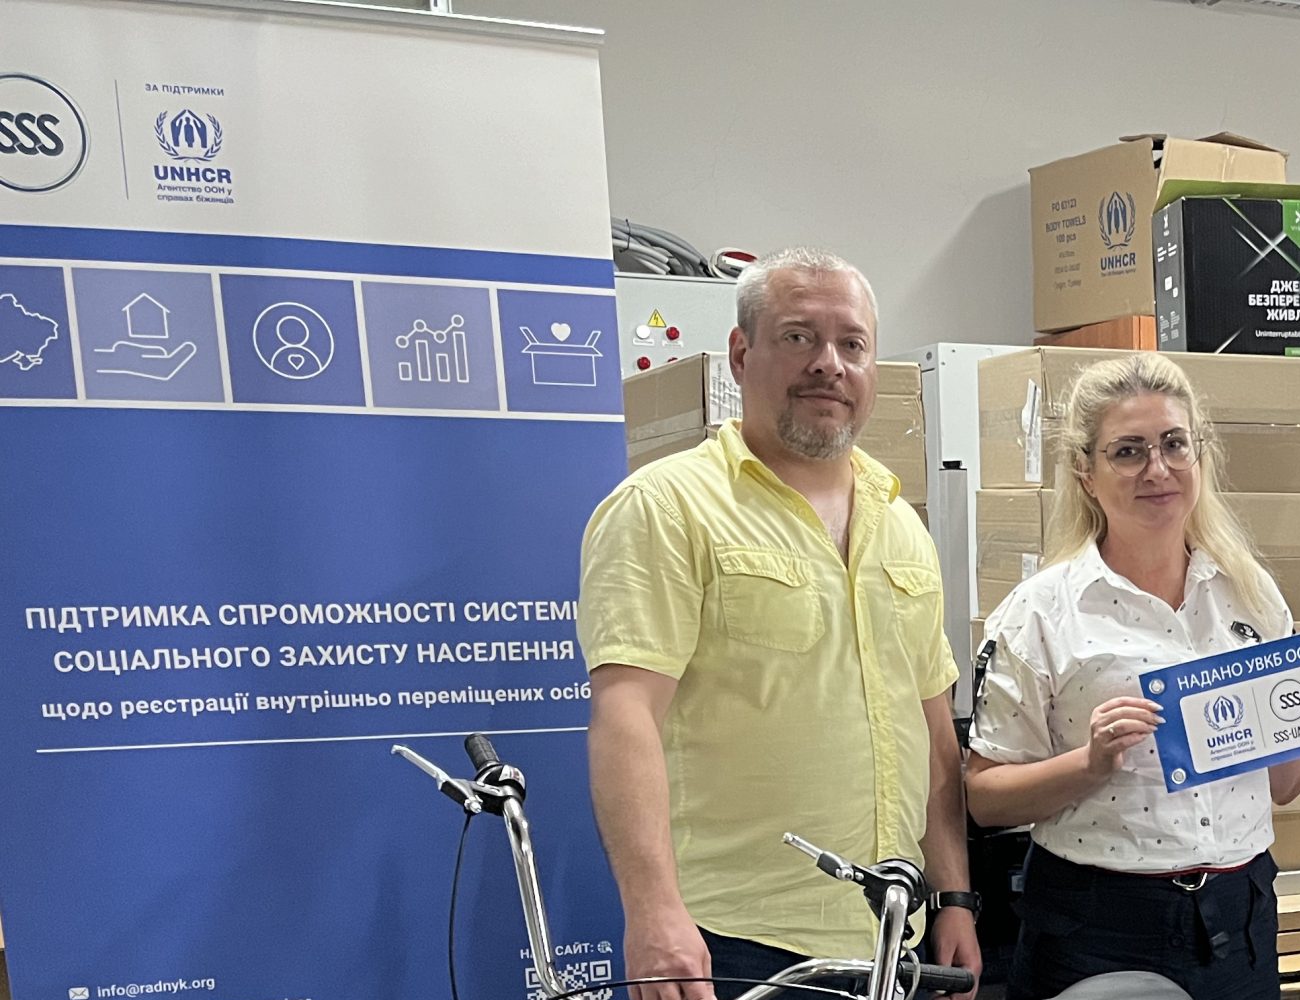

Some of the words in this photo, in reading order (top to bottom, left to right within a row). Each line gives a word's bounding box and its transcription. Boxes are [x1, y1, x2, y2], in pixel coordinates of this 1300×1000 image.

[145, 83, 159, 92] ЗА
[162, 84, 225, 97] ПІДТРИМКИ
[154, 165, 232, 184] UNHCR
[204, 185, 225, 194] ООН
[1100, 252, 1136, 271] UNHCR
[25, 605, 211, 632] ПІДТРИМКА
[218, 602, 455, 627] СПРОМОЖНОСТІ
[53, 646, 271, 676] СОЦІАЛЬНОГО
[279, 643, 408, 667] ЗАХИСТУ
[417, 640, 574, 664] НАСЕЛЕННЯ
[1177, 662, 1243, 691] НАДАНО
[1245, 652, 1283, 674] УВКБ
[42, 698, 113, 720] щодо
[120, 691, 249, 719] реєстрації
[256, 687, 392, 715] внутрішньо
[398, 683, 544, 709] переміщених
[550, 681, 592, 701] осіб
[1207, 728, 1253, 748] UNHCR
[555, 942, 594, 957] САЙТ:
[97, 977, 216, 998] info@radnyk.org
